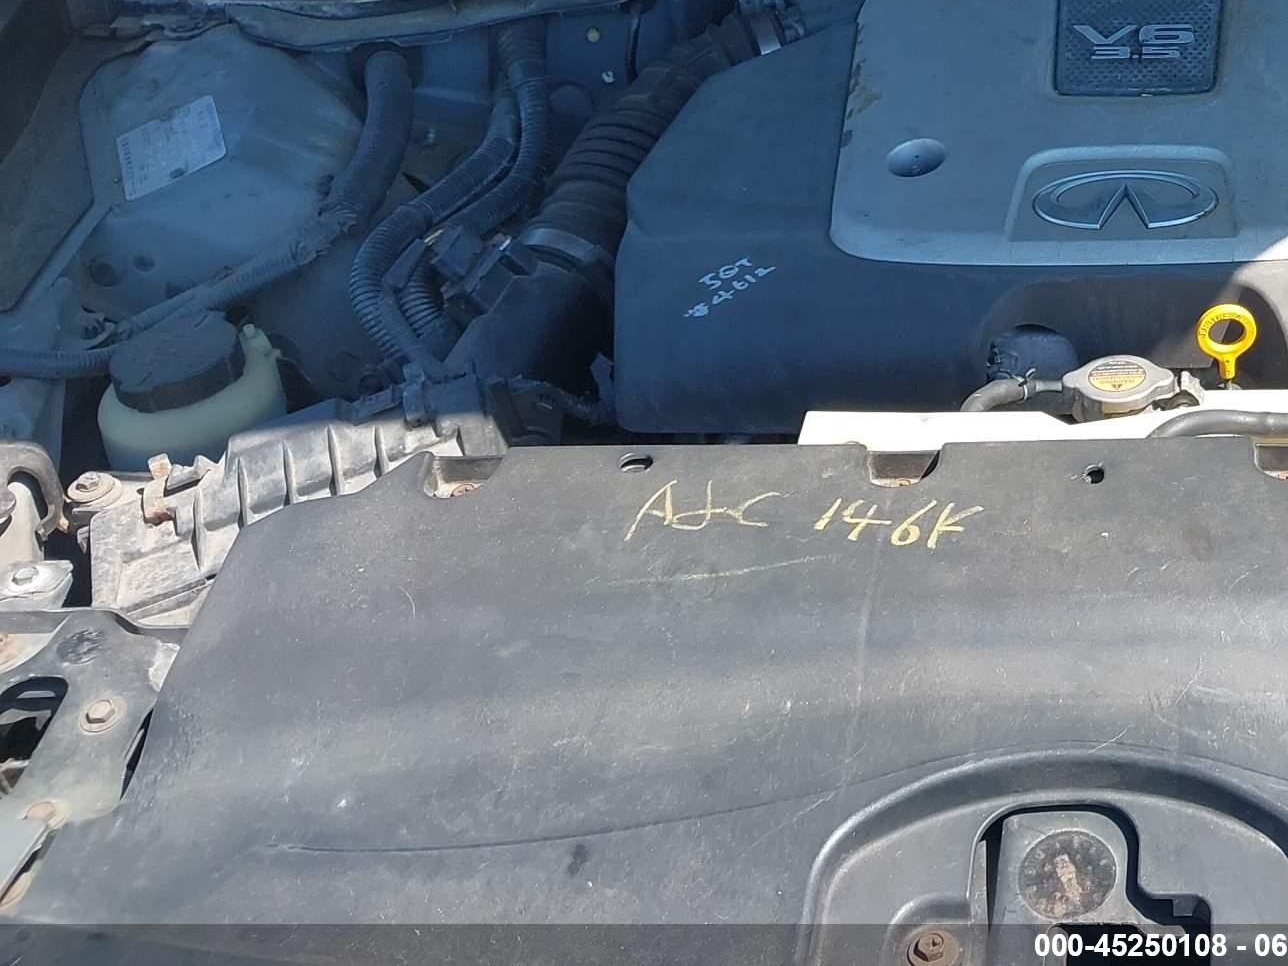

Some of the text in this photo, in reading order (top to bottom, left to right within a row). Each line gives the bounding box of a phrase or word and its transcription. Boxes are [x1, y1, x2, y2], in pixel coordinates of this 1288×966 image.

[1072, 23, 1196, 44] V6
[1090, 46, 1182, 60] 3.5
[812, 497, 985, 550] 146K
